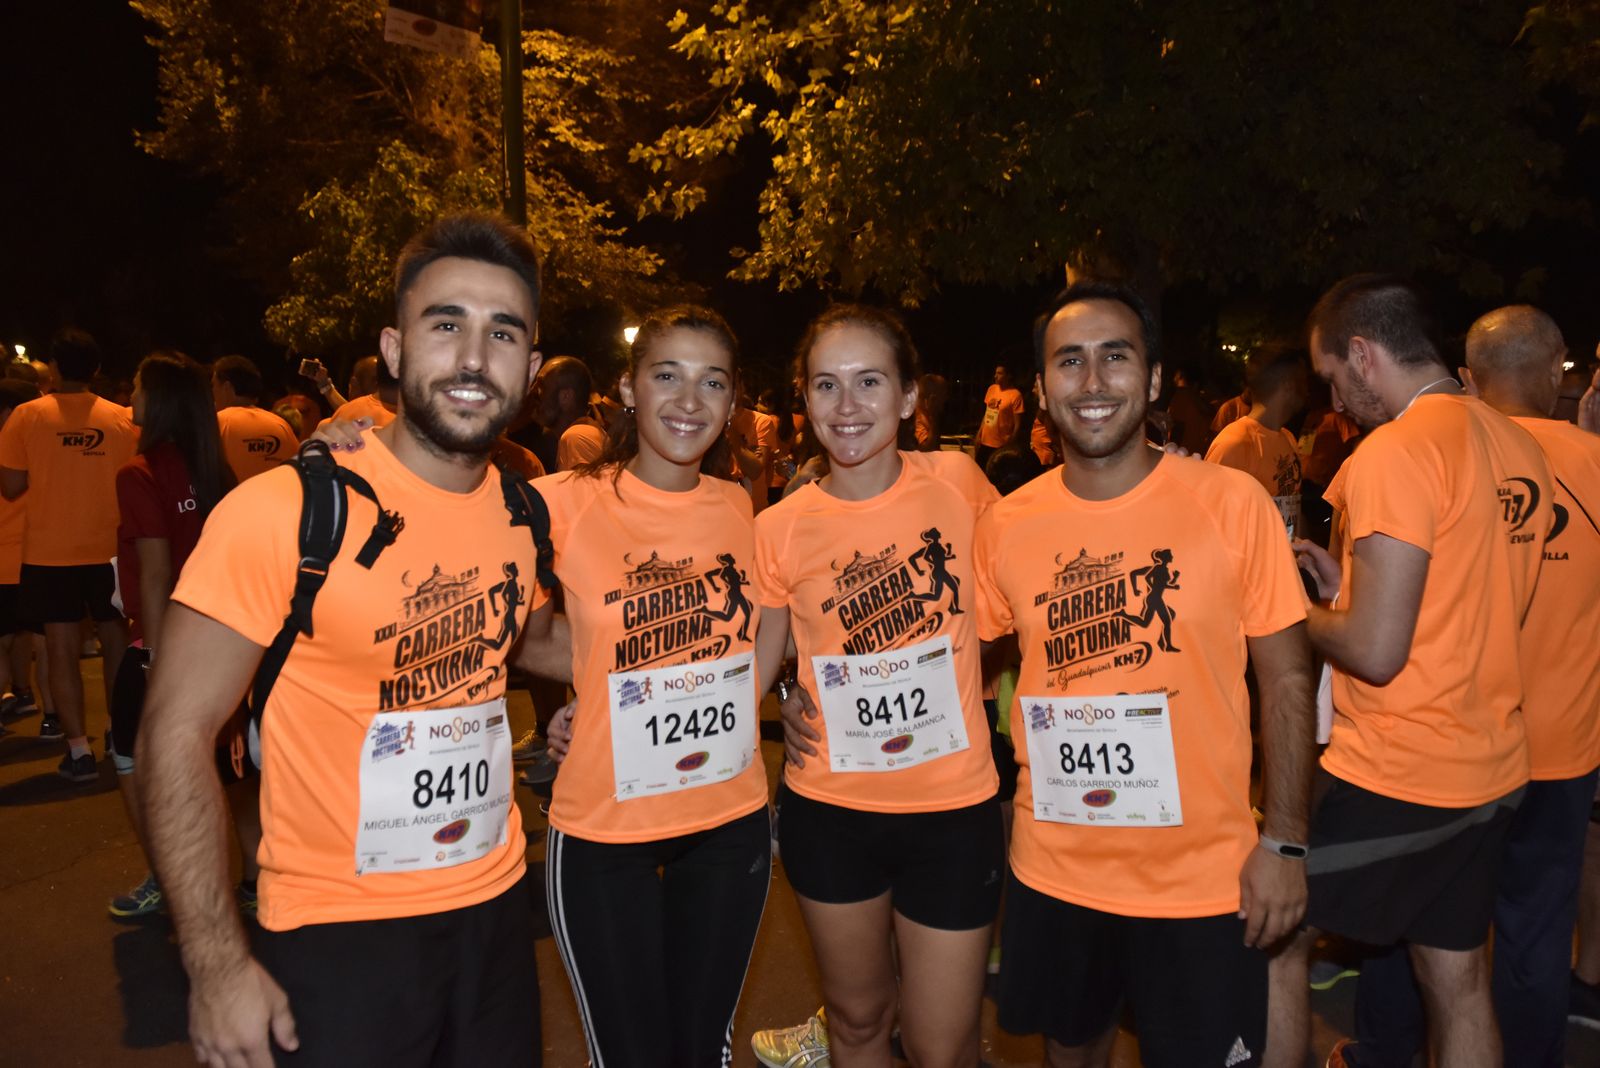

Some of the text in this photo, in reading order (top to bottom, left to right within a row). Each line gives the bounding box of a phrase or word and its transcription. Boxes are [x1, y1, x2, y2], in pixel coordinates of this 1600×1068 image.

[604, 589, 621, 606] XXXI
[623, 578, 708, 631] CARRERA
[838, 565, 914, 631] CARRERA
[1047, 578, 1127, 631] CARRERA
[374, 623, 397, 644] XXXI
[394, 598, 487, 669] CARRERA
[615, 615, 712, 670] NOCTURNA
[842, 600, 926, 656] NOCTURNA
[1044, 617, 1132, 667] NOCTURNA
[379, 644, 485, 711] NOCTURNA
[645, 702, 735, 746] 12426
[845, 713, 946, 739] MARÍA JOSÉ SALAMANCA
[856, 688, 928, 727] 8412
[1046, 777, 1159, 789] CARLOS GARRIDO MUÑOZ
[1059, 742, 1135, 775] 8413
[412, 759, 489, 809] 8410
[364, 816, 409, 831] MIGUEL
[412, 811, 448, 827] ÁNGEL
[451, 802, 489, 820] GARRIDO
